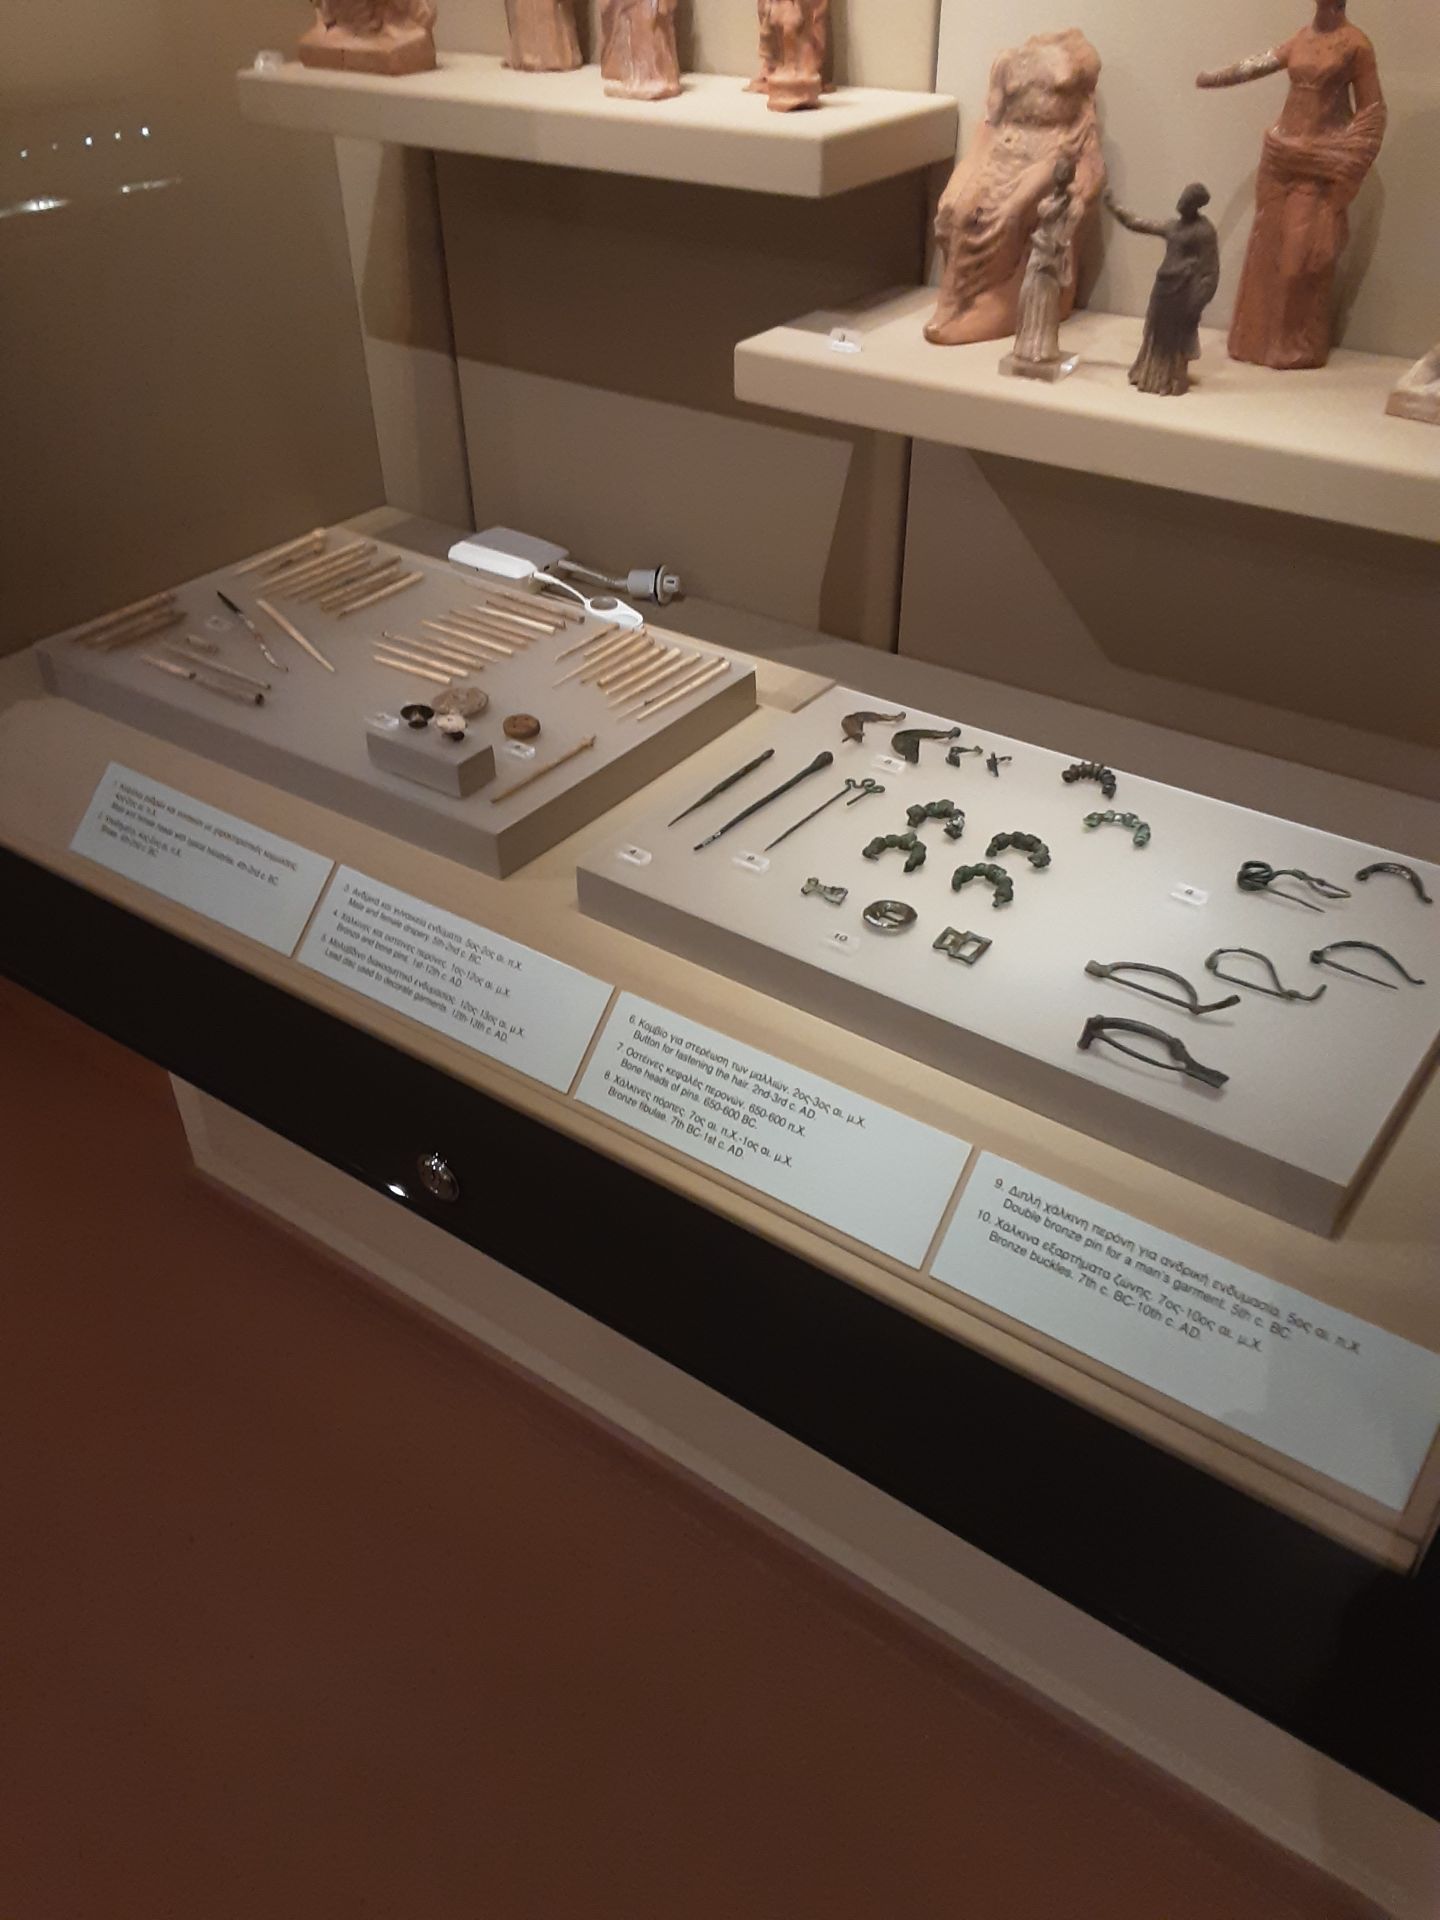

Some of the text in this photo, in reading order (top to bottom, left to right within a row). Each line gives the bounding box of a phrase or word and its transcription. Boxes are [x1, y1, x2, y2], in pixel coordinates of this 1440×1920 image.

[620, 1057, 643, 1075] Bone
[643, 1068, 670, 1088] heads
[703, 1097, 741, 1121] 650-600
[632, 1029, 661, 1049] Button
[661, 1043, 674, 1055] for
[675, 1048, 714, 1075] fastening
[715, 1067, 730, 1081] the
[751, 1083, 789, 1108] 2nd-3rd
[669, 1033, 684, 1046] για
[731, 1061, 749, 1075] των
[792, 1087, 831, 1114] 2ος-3ος
[607, 1086, 638, 1107] Bronze
[670, 1115, 685, 1130] 7th
[686, 1123, 717, 1146] BC-1st
[688, 1110, 706, 1127] 7ος
[748, 1103, 787, 1128] 650-600
[1002, 1198, 1041, 1223] Double
[1043, 1217, 1083, 1242] bronze
[1083, 1238, 1103, 1252] pin
[1105, 1245, 1123, 1260] for
[1230, 1303, 1251, 1318] 5th
[1092, 1224, 1135, 1252] περόνη
[1139, 1246, 1158, 1261] για
[988, 1230, 1028, 1257] Bronze
[1078, 1272, 1097, 1289] 7th
[1113, 1289, 1162, 1321] BC-10th
